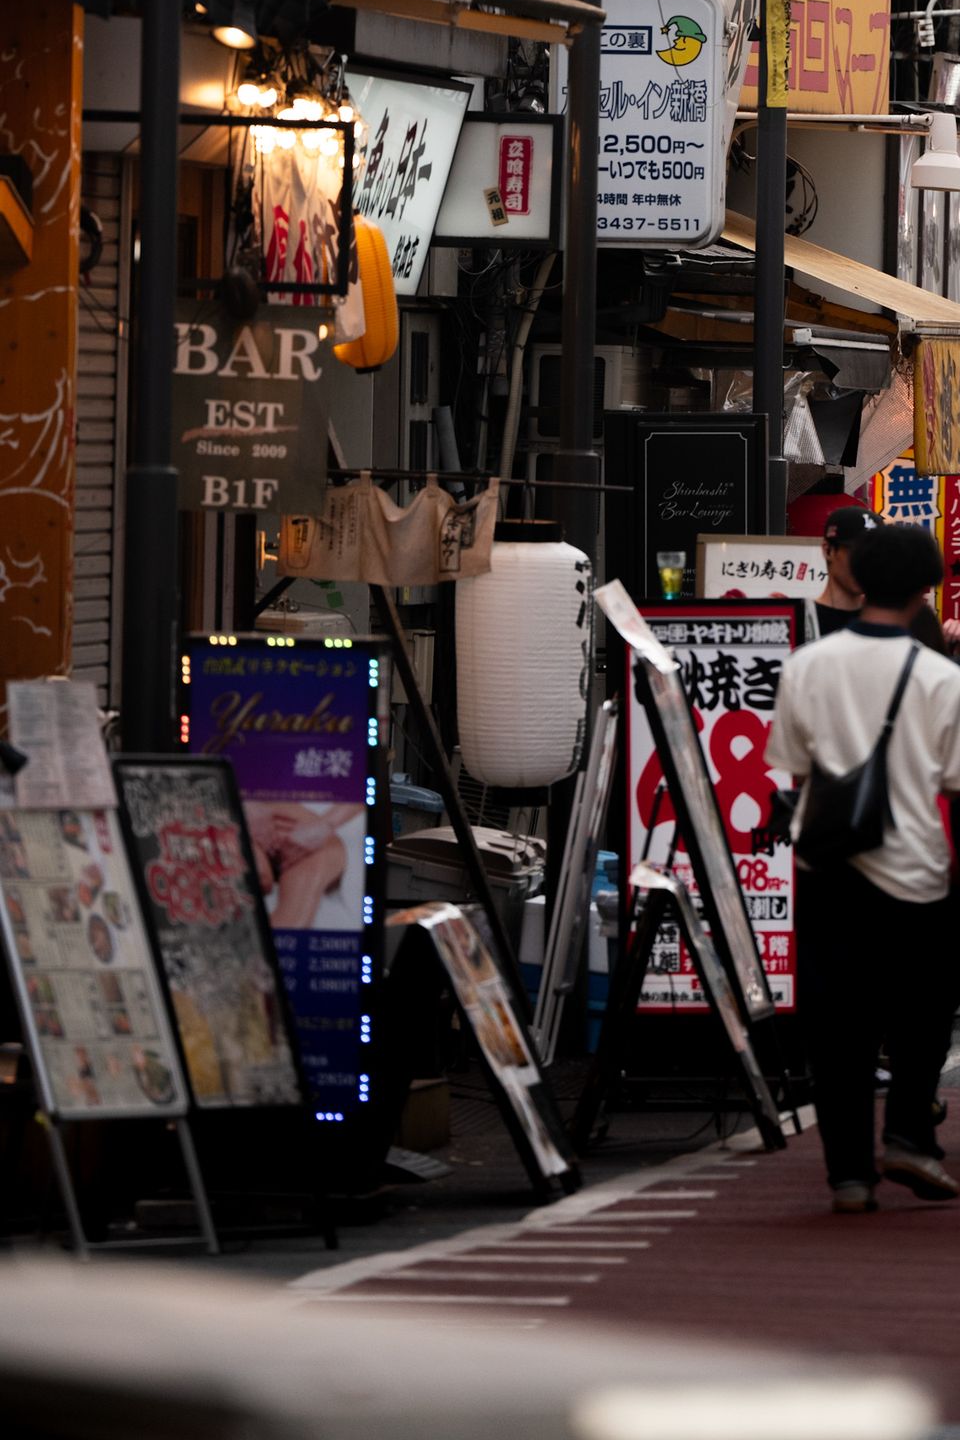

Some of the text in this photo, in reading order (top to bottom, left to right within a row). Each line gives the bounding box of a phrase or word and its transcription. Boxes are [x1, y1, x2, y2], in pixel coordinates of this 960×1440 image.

[632, 193, 682, 206] 年中無休
[597, 217, 700, 232] 3437-5511
[172, 322, 323, 382] BAR
[205, 398, 285, 433] EST
[195, 439, 288, 459] Since 2009
[201, 474, 280, 509] B1F
[664, 480, 729, 500] Shinbashi
[722, 558, 795, 580] にぎり寿司
[203, 690, 353, 754] Yuraku
